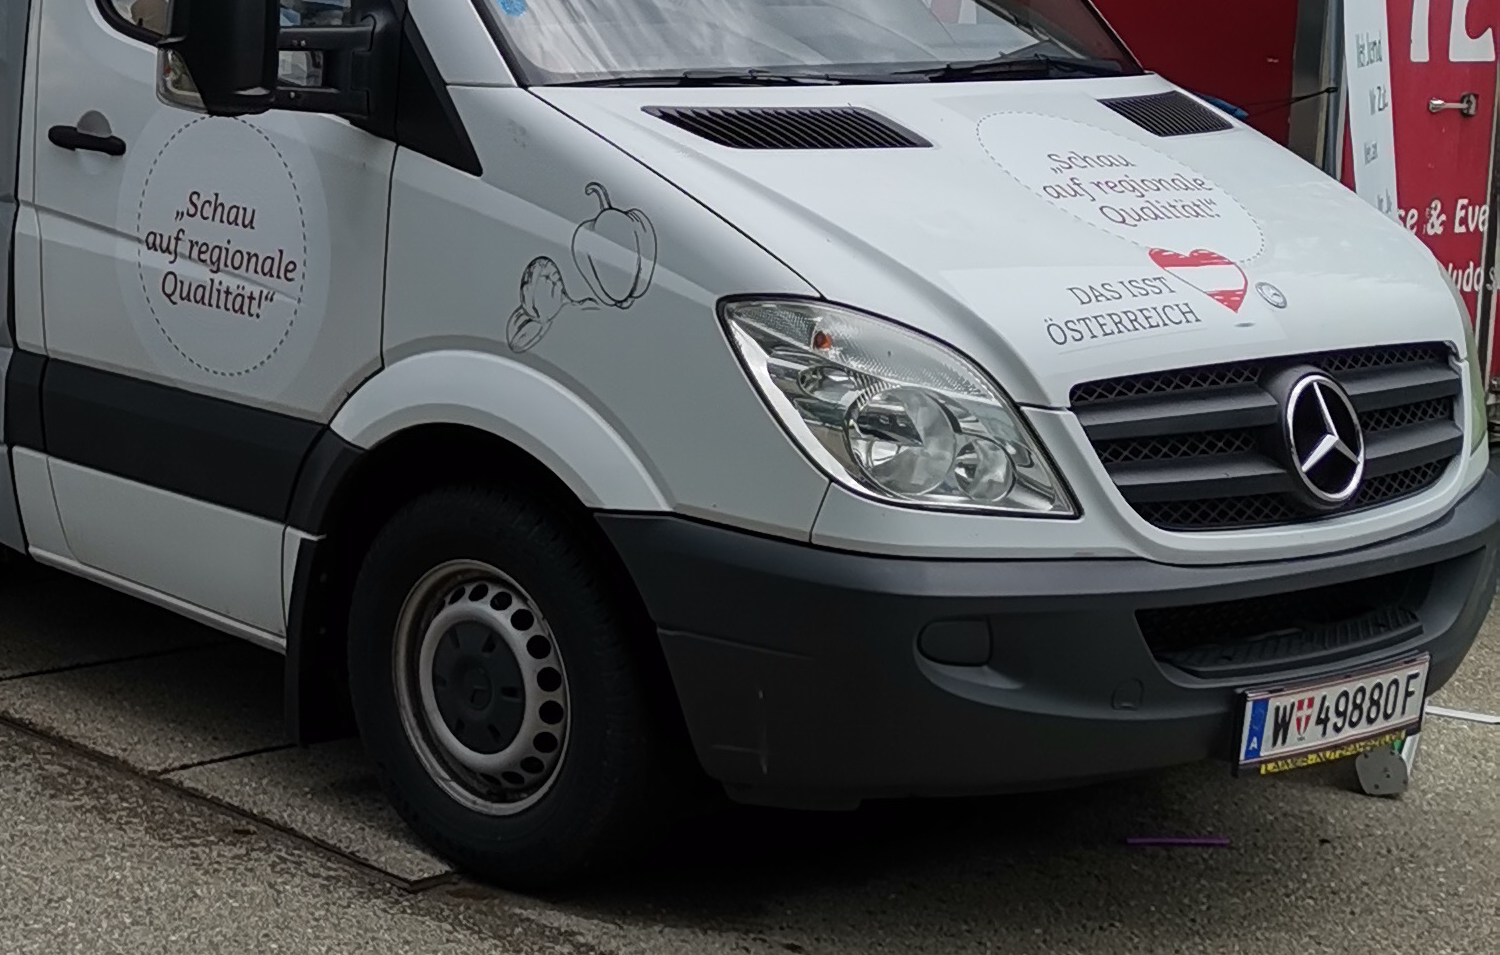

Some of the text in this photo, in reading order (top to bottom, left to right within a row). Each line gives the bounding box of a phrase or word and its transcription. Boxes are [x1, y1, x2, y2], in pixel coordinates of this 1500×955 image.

[1043, 173, 1213, 202] auf regionale
[174, 190, 256, 230] „Schau
[145, 228, 297, 283] auf regionale
[1068, 276, 1177, 305] DAS ISST
[1044, 301, 1202, 345] ÖSTERREICH
[1271, 670, 1421, 748] W 49880F
[1248, 739, 1259, 751] A
